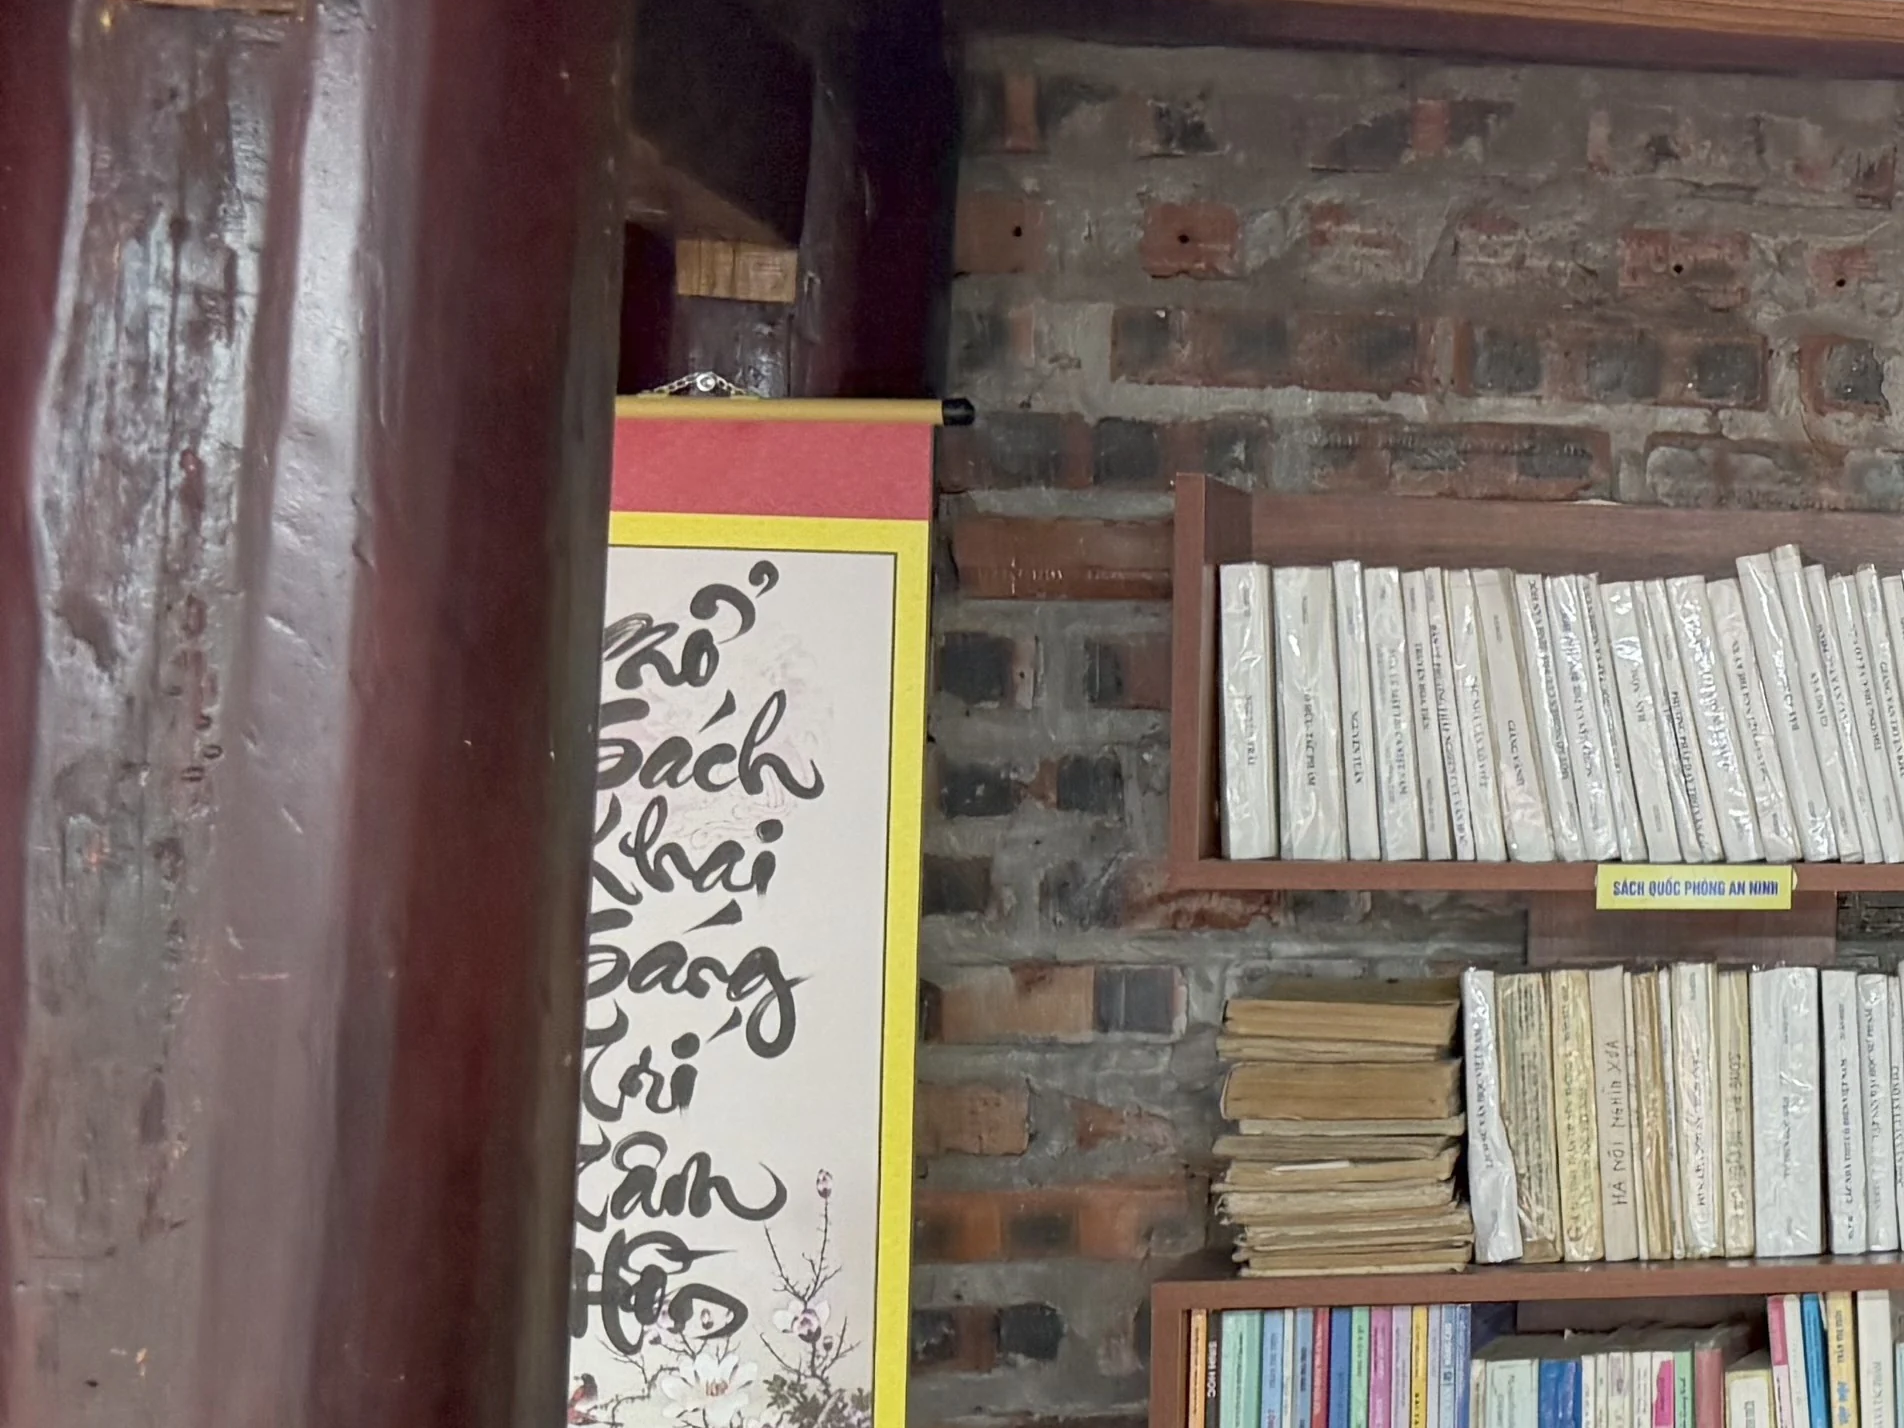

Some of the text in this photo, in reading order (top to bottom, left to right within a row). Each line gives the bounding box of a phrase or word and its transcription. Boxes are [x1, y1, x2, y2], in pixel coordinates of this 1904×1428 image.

[1613, 878, 1778, 897] SÁCH QUỐC PHÒNG AN NINH
